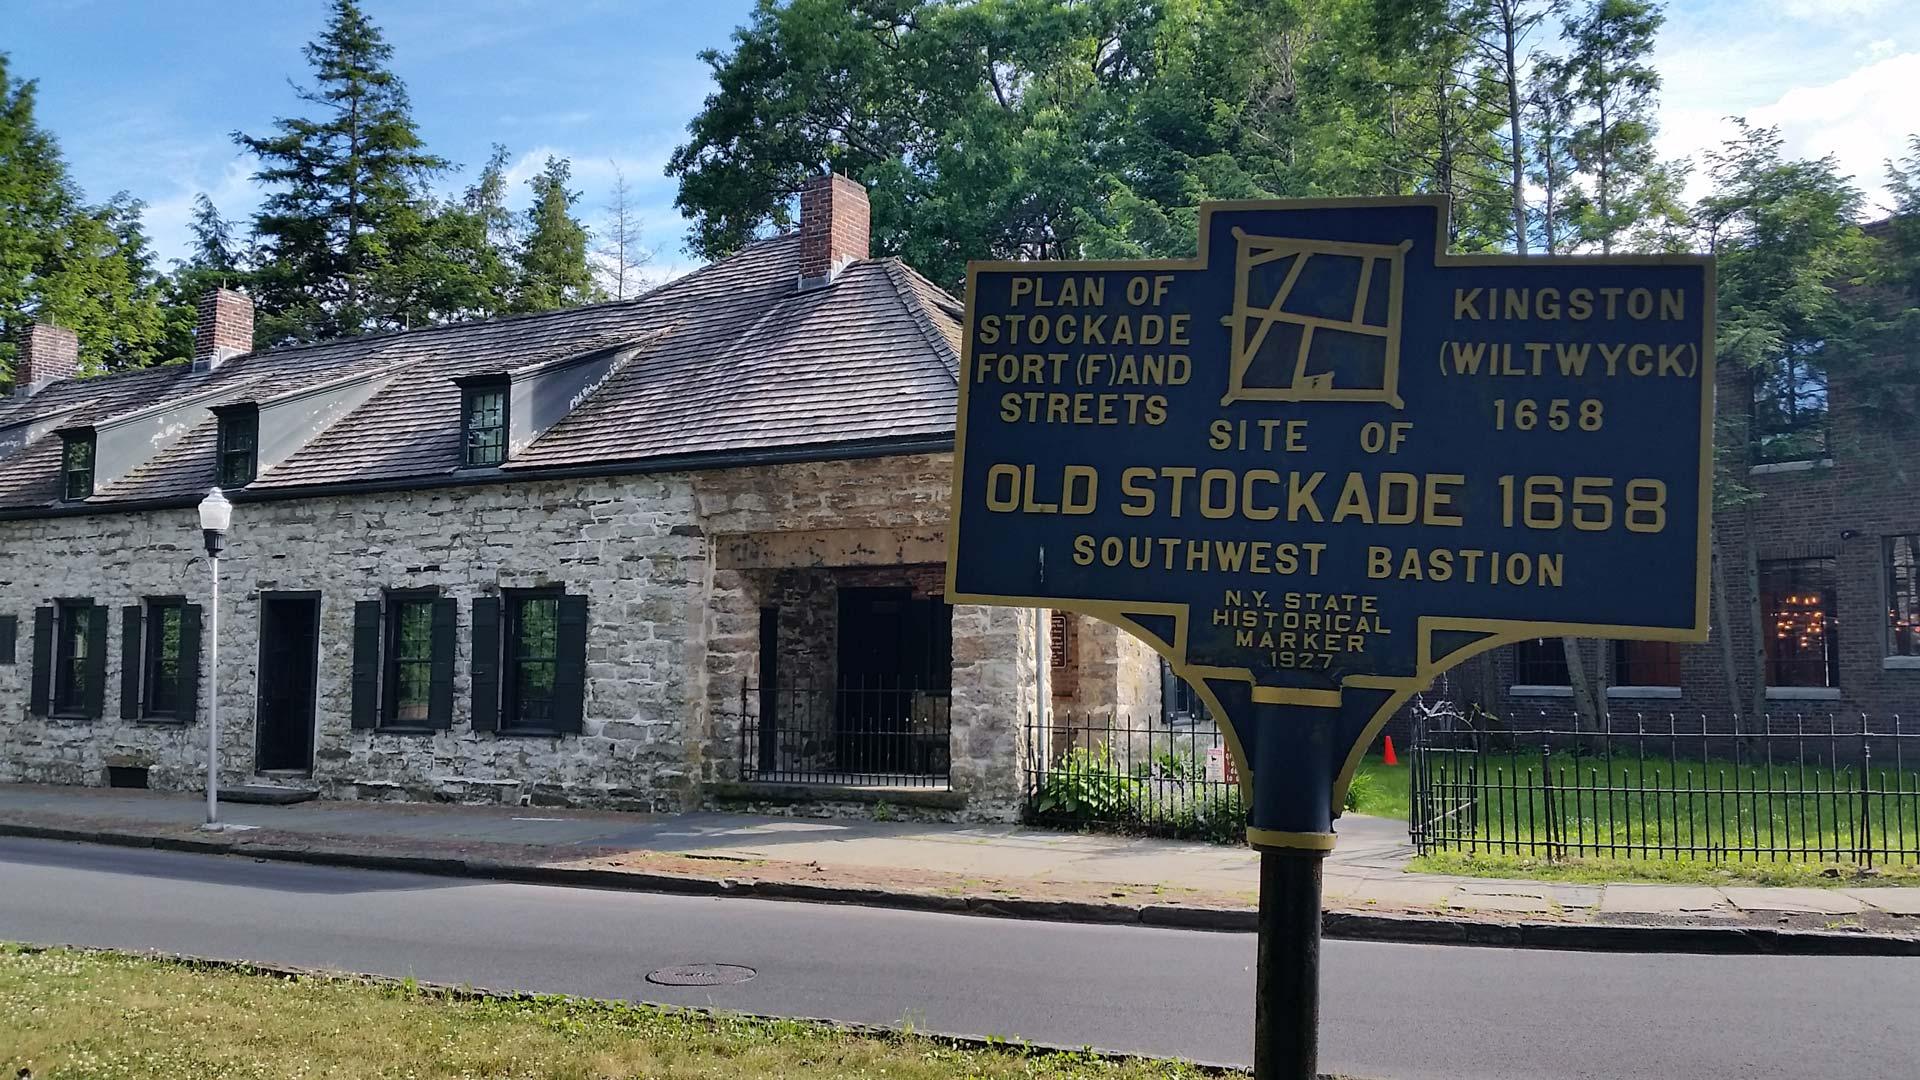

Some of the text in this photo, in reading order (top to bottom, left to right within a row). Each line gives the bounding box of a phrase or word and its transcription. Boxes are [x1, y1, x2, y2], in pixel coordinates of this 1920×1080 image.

[1010, 275, 1175, 307] PLAN OF
[1453, 287, 1687, 321] KINGSTON
[979, 314, 1191, 345] STOCKADE
[977, 353, 1069, 384] FORT
[1440, 341, 1698, 379] (WILTWYCK)
[1000, 392, 1168, 425] STREETS
[1494, 399, 1604, 431] 1658
[1208, 419, 1414, 454] SITE OF
[986, 463, 1668, 533] OLD STOCKADE 1658
[1073, 535, 1565, 588] SOUTHWEST BASTION
[1225, 590, 1379, 614] N.Y. STATE
[1212, 608, 1392, 634] HISTORICAL
[1235, 631, 1366, 653] MARKER
[1270, 651, 1334, 669] 1927
